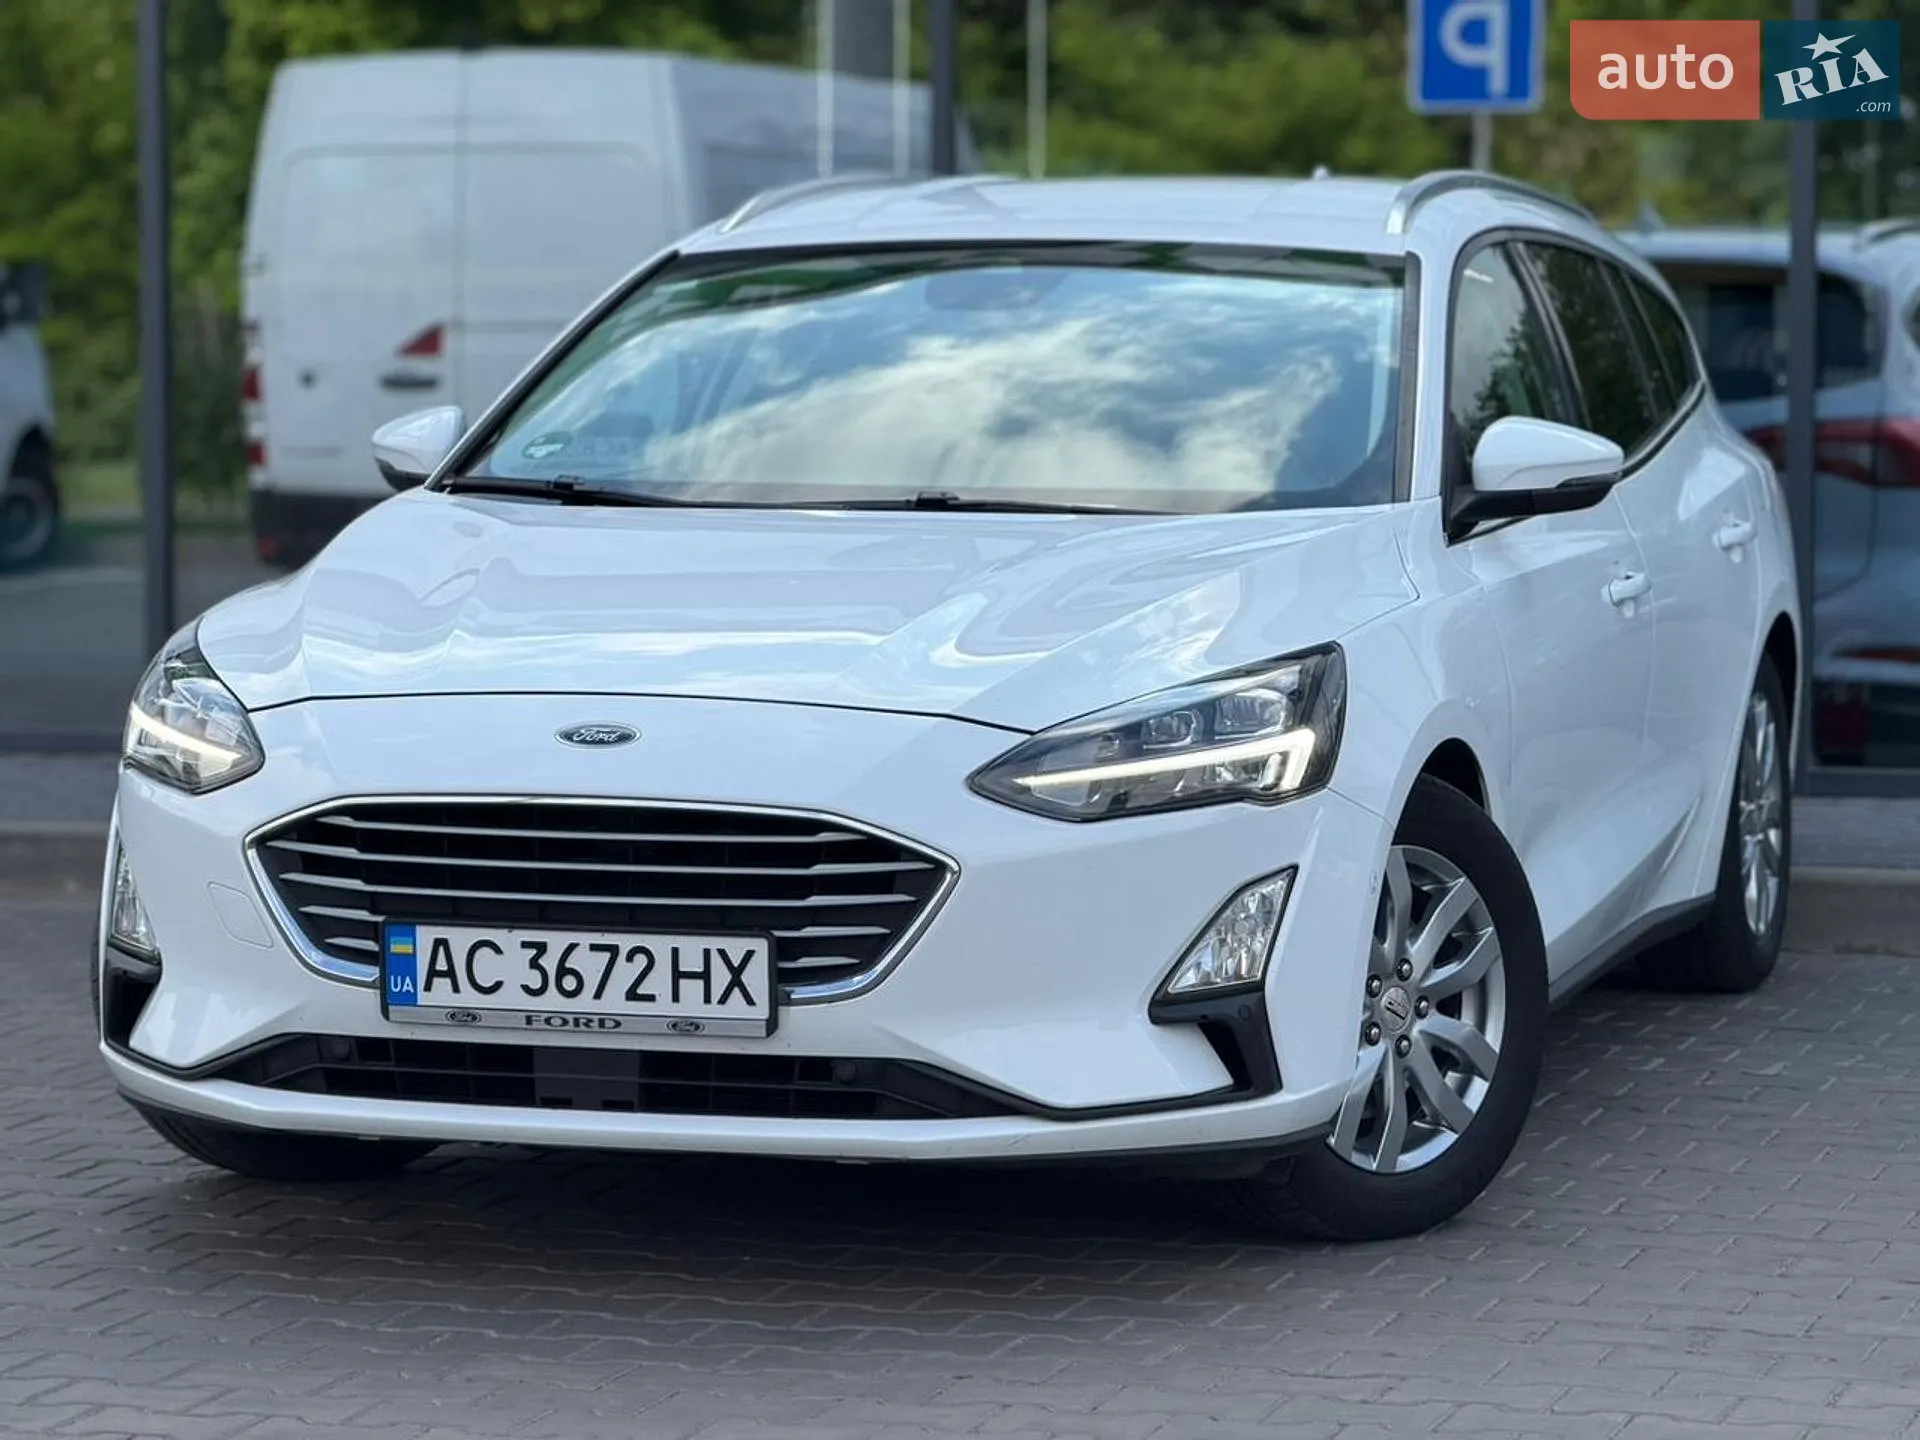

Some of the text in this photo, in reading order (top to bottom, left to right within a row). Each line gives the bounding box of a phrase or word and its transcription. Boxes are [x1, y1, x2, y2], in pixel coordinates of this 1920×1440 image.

[423, 937, 757, 1006] AC 3672 HX
[391, 975, 415, 994] UA
[525, 1014, 623, 1030] FORD
